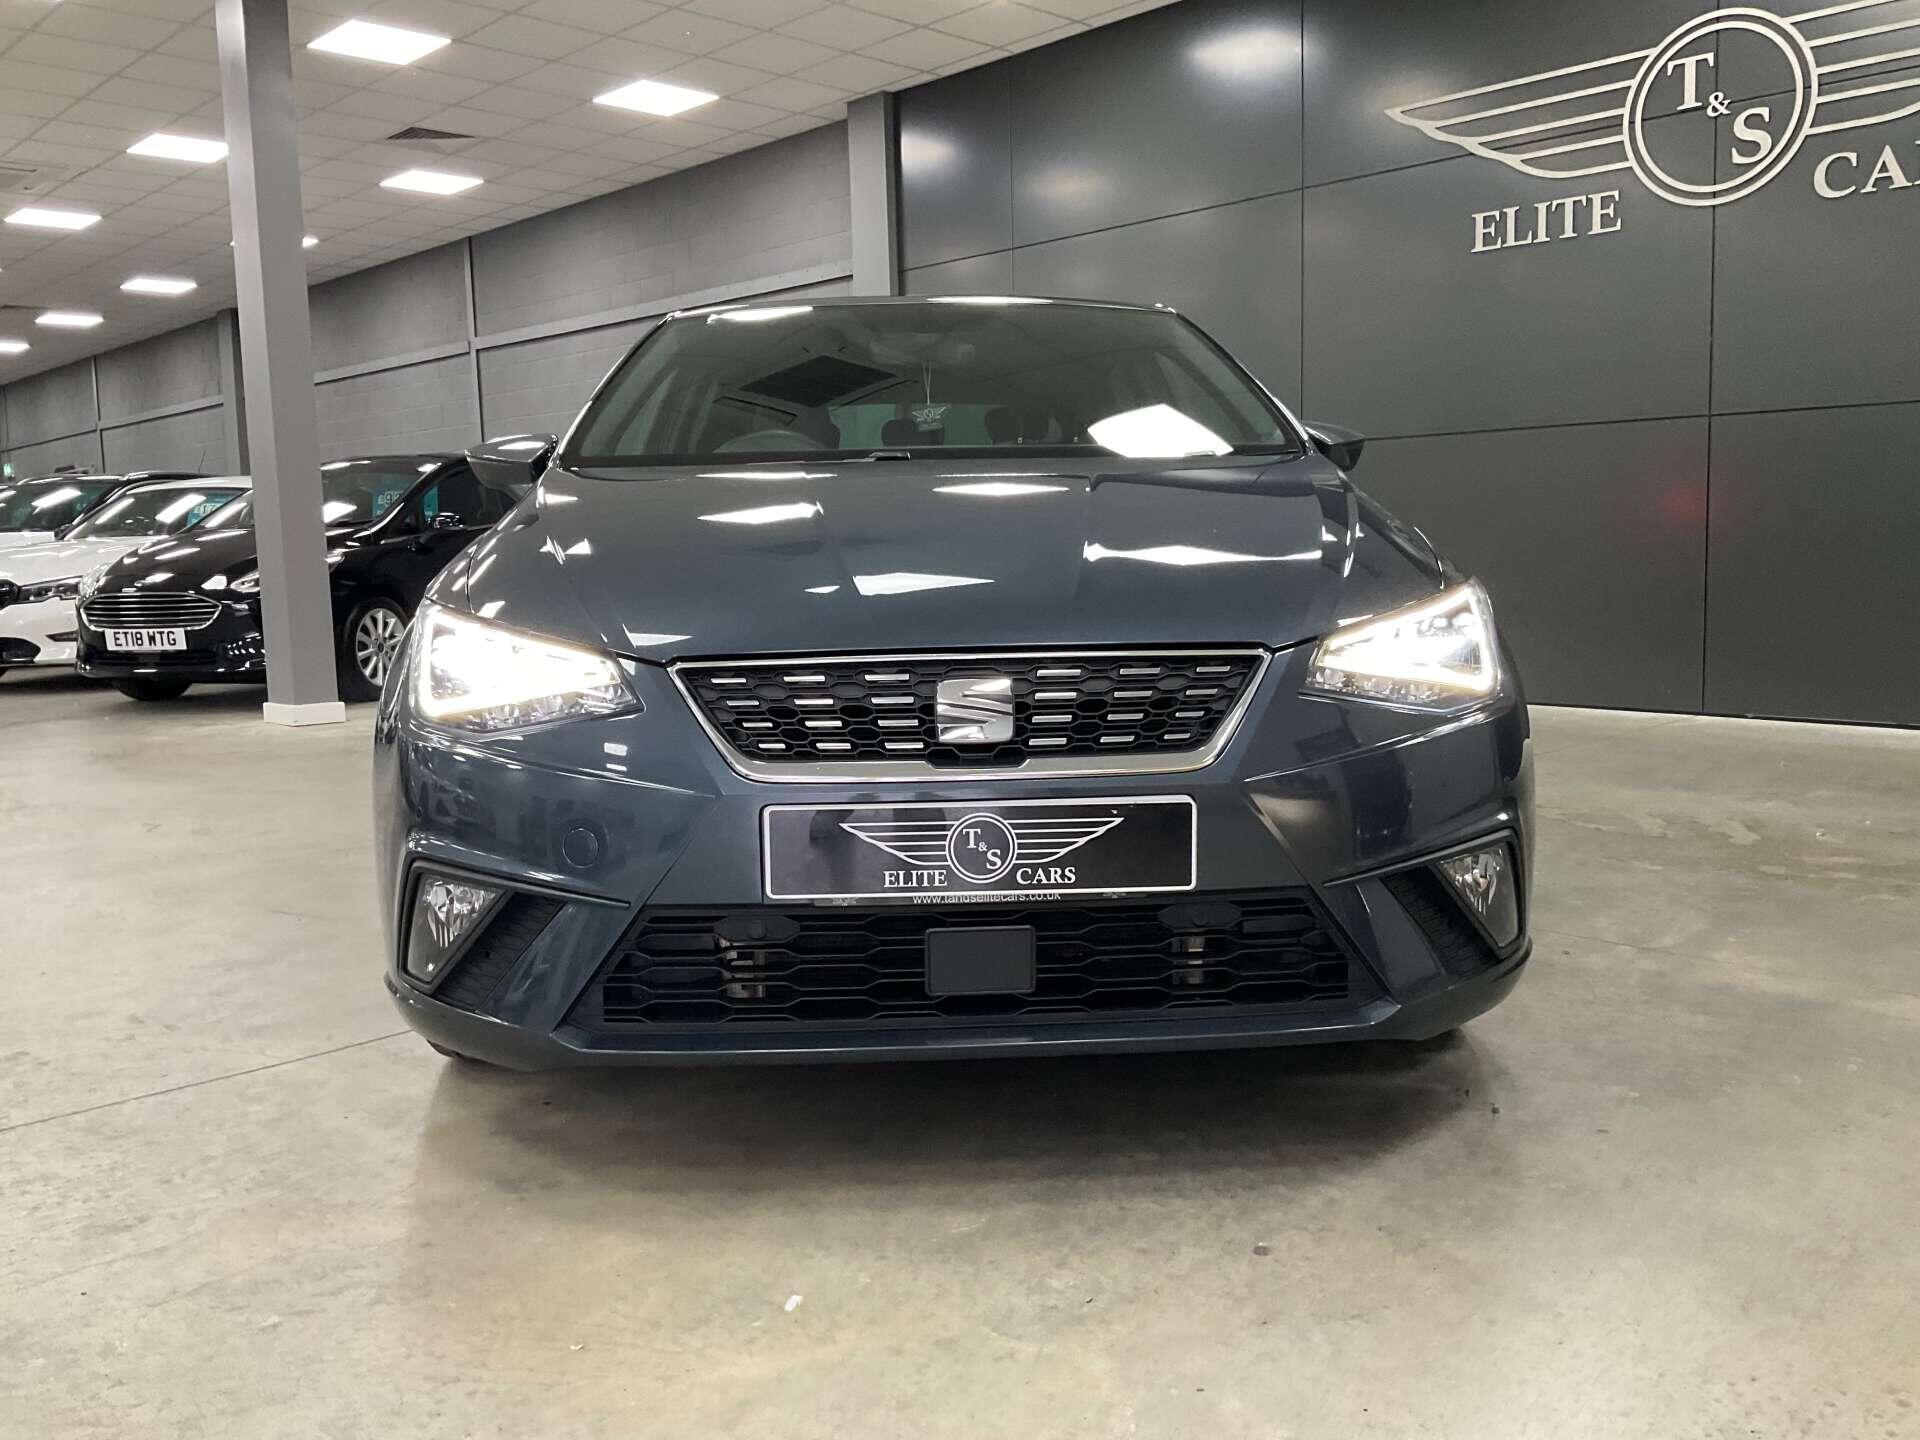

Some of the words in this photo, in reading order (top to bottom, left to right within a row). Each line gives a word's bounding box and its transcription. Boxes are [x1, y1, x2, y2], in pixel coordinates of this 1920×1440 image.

[1471, 190, 1622, 253] ELITE
[1813, 141, 1920, 198] CA
[113, 631, 144, 647] ET18
[146, 630, 177, 647] WTG
[883, 869, 947, 888] ELITE
[1016, 867, 1076, 885] CARS
